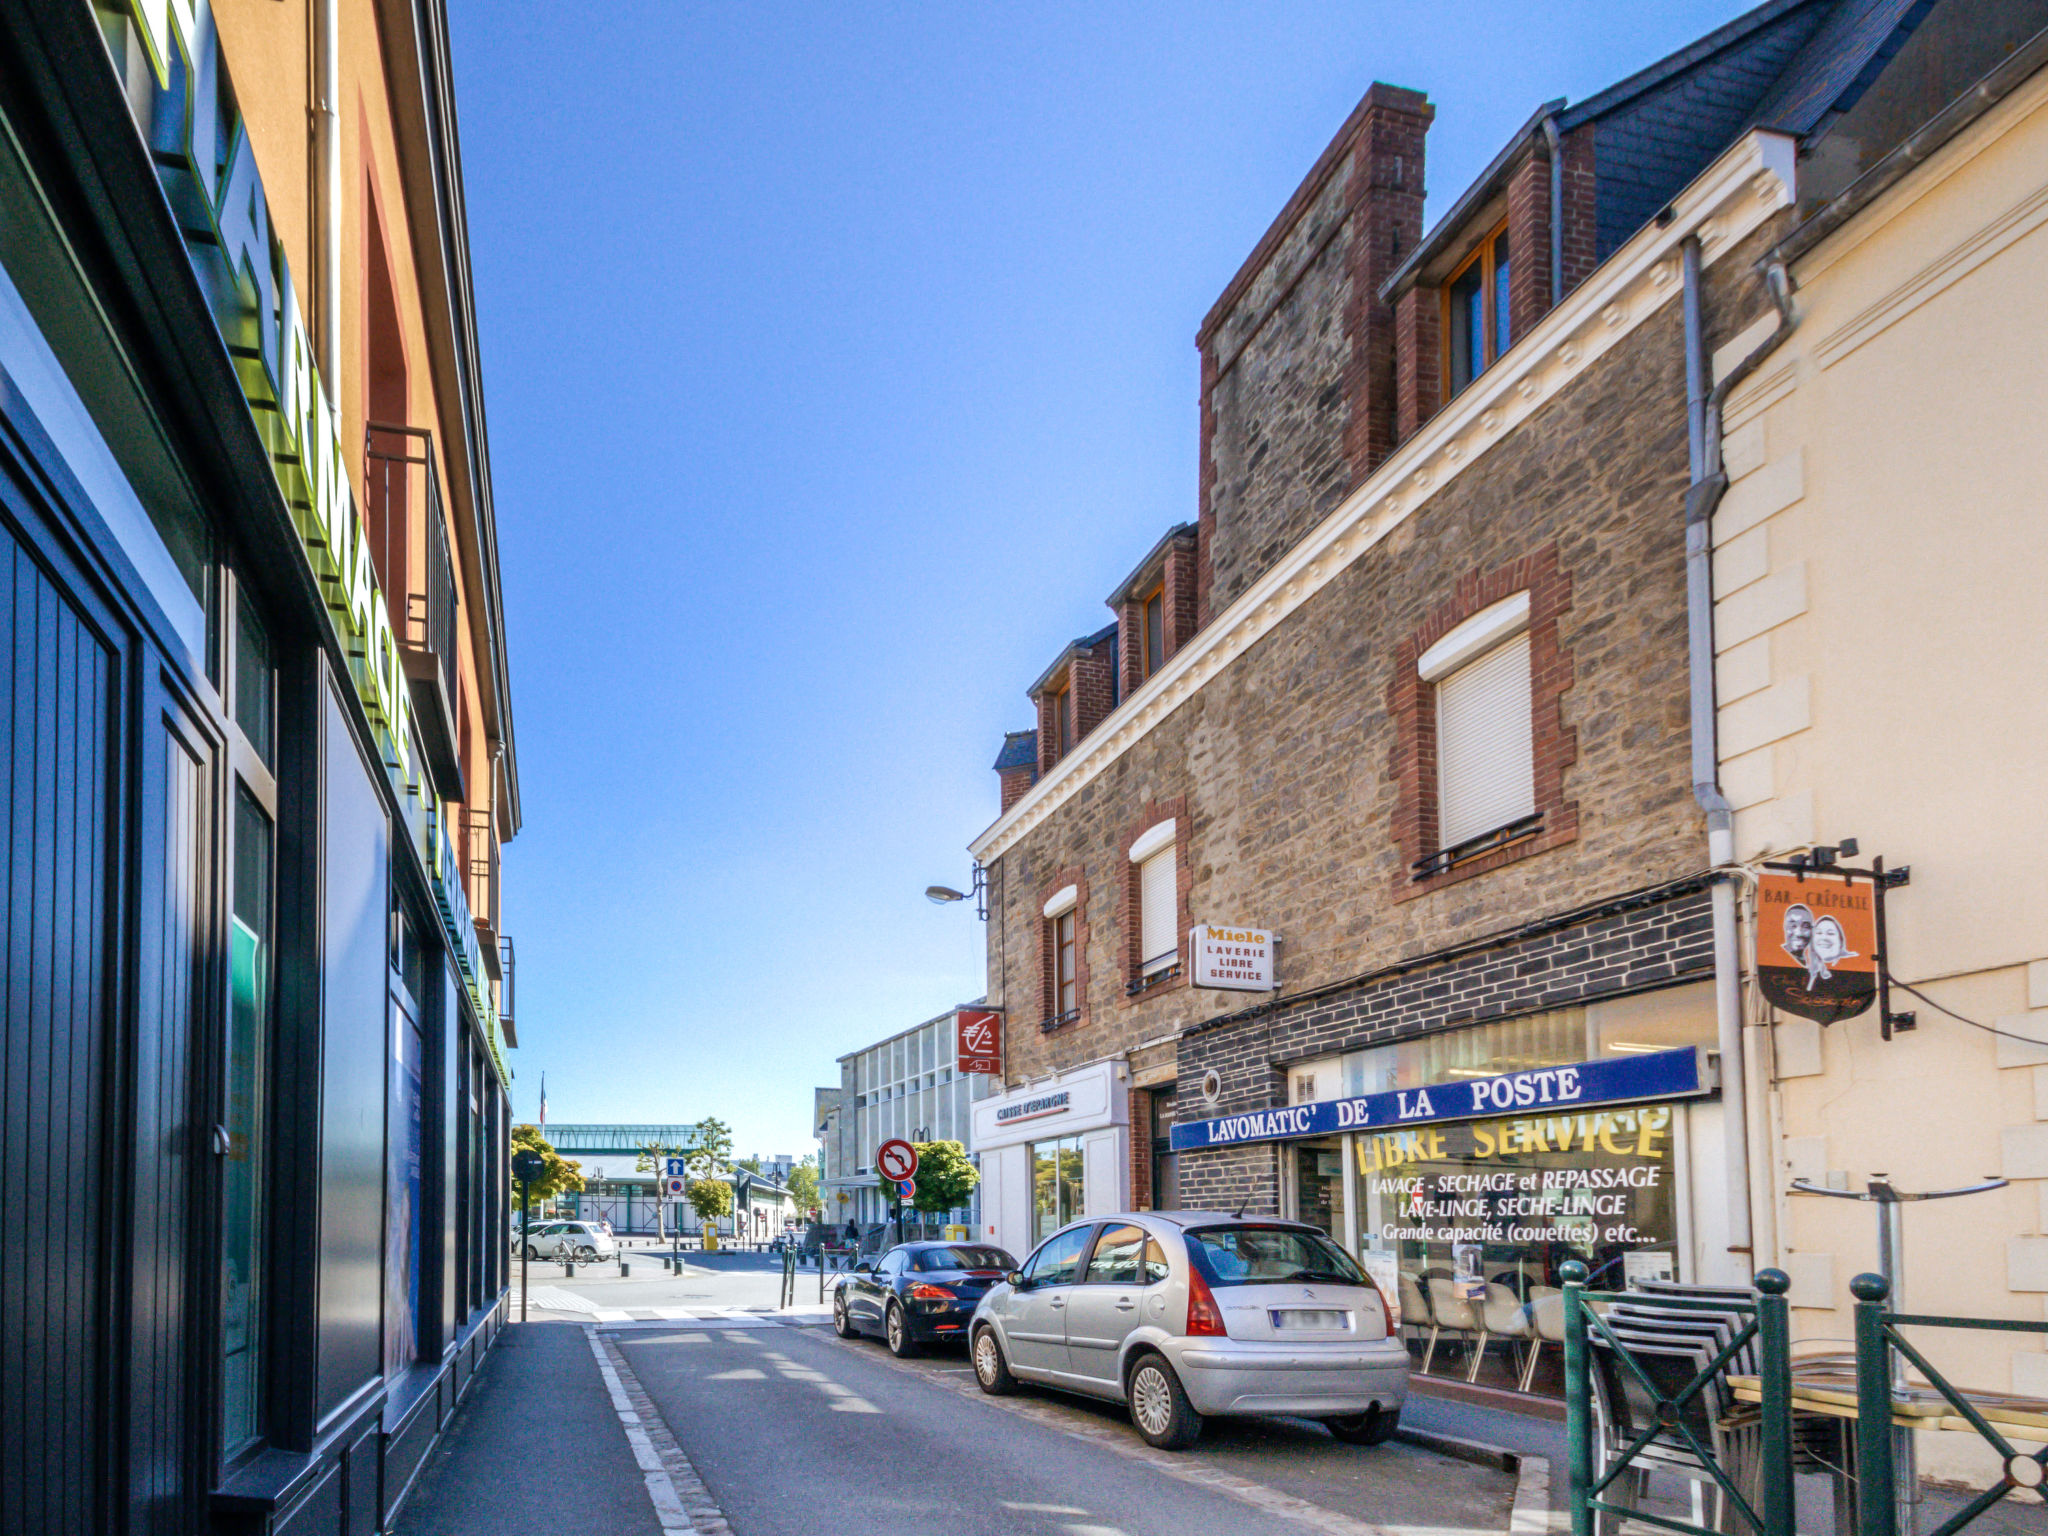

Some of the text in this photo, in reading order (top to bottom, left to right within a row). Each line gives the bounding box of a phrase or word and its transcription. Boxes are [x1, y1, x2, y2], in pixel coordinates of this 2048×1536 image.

[1764, 889, 1791, 904] BAR
[1806, 889, 1870, 910] CRÊPERIE
[1207, 928, 1265, 944] Miele
[1207, 945, 1265, 958] LAVERIE
[1210, 969, 1262, 981] SERVICE
[1219, 958, 1253, 969] LIBRE
[1336, 1099, 1369, 1127] DE
[1397, 1089, 1435, 1119] LA
[1470, 1067, 1582, 1111] POSTE
[1356, 1112, 1667, 1176] LIBRE SERVICE
[1371, 1176, 1425, 1195] LAVAGE
[1437, 1173, 1517, 1193] SECHAGE
[1519, 1172, 1537, 1191] et
[1542, 1166, 1662, 1190] REPASSAGE
[1399, 1194, 1628, 1221] LAVE-LINGE, SECHE-LINGE
[1382, 1221, 1657, 1246] Grande capacité (couettes) etc...
